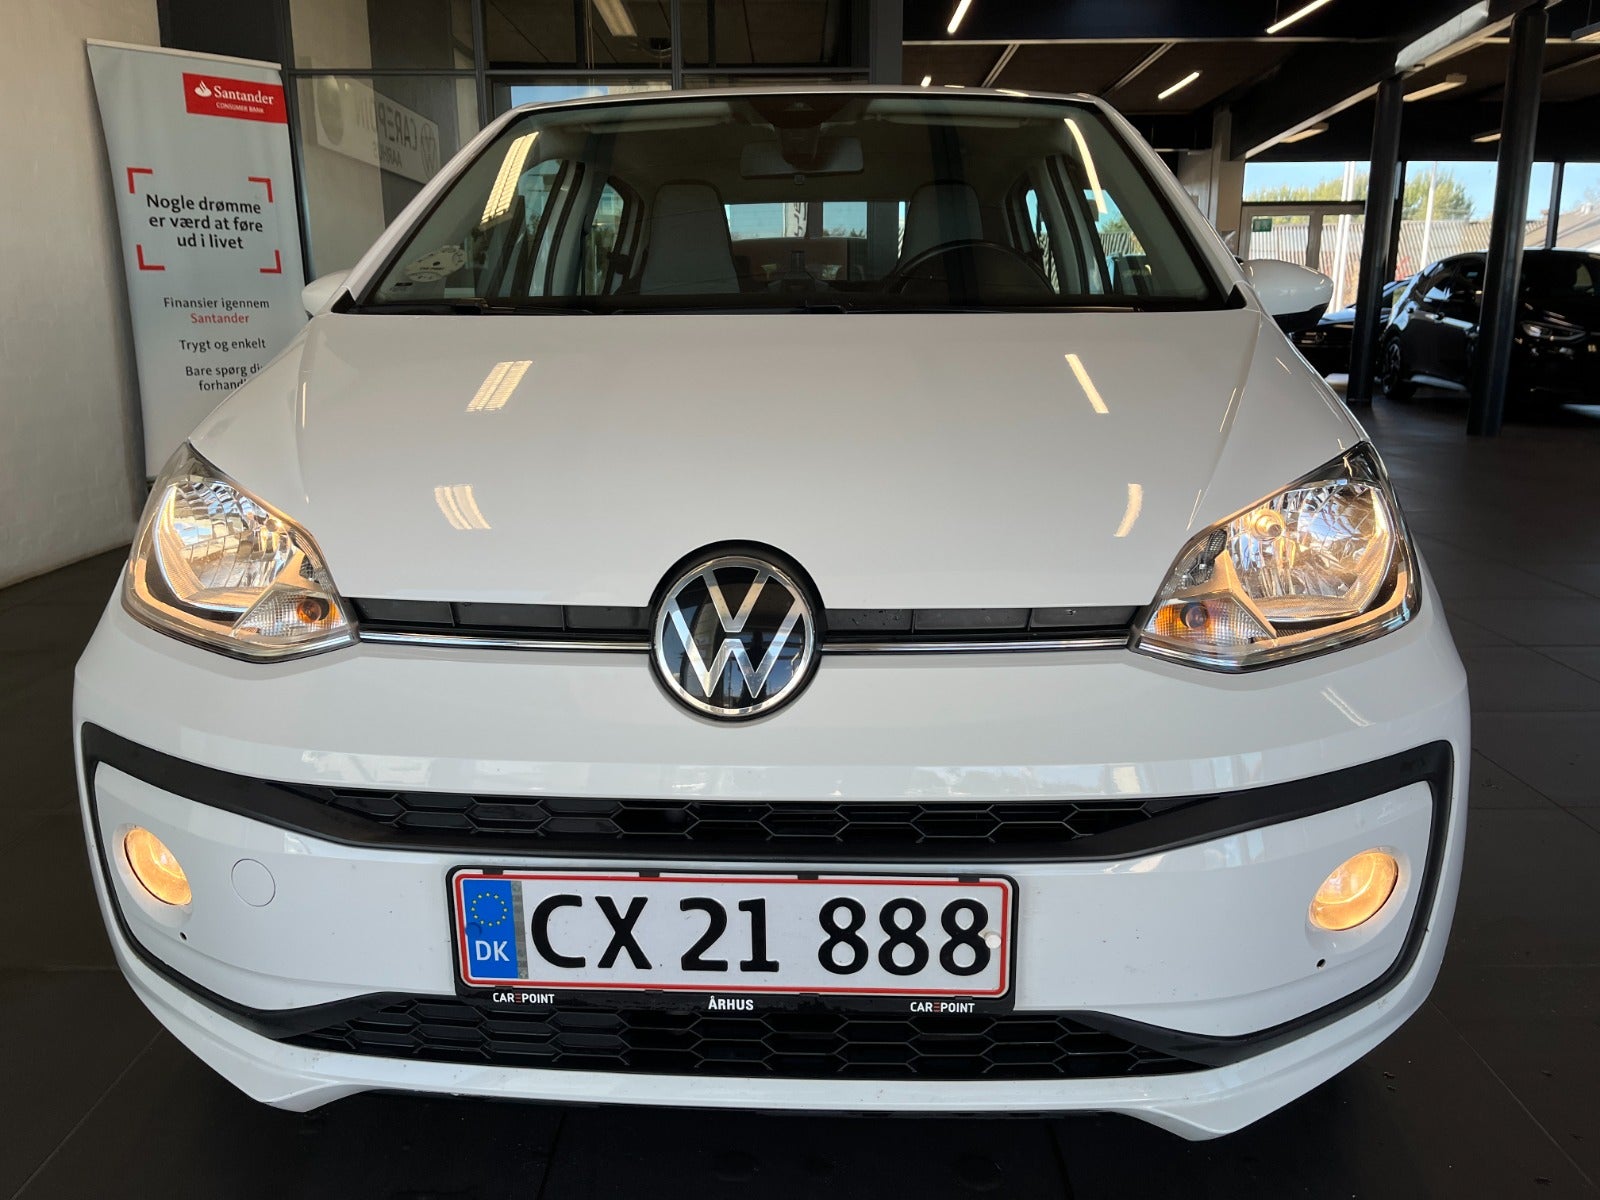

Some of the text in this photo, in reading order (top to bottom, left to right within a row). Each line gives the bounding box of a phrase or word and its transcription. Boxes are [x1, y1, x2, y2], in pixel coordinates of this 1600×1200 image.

[213, 85, 274, 105] Santander
[216, 101, 265, 114] CONSUMER BANK
[146, 194, 261, 214] Nogle drømme
[149, 216, 263, 232] er værd at føre
[177, 233, 244, 249] ud i livet
[163, 297, 270, 311] Finansier igennem
[190, 313, 250, 324] Santander
[179, 338, 266, 353] Trygt og enkelt
[185, 363, 263, 377] Bare spørg di
[531, 894, 991, 976] CX 21 888
[475, 940, 510, 962] DK
[708, 995, 754, 1011] ÅRHUS
